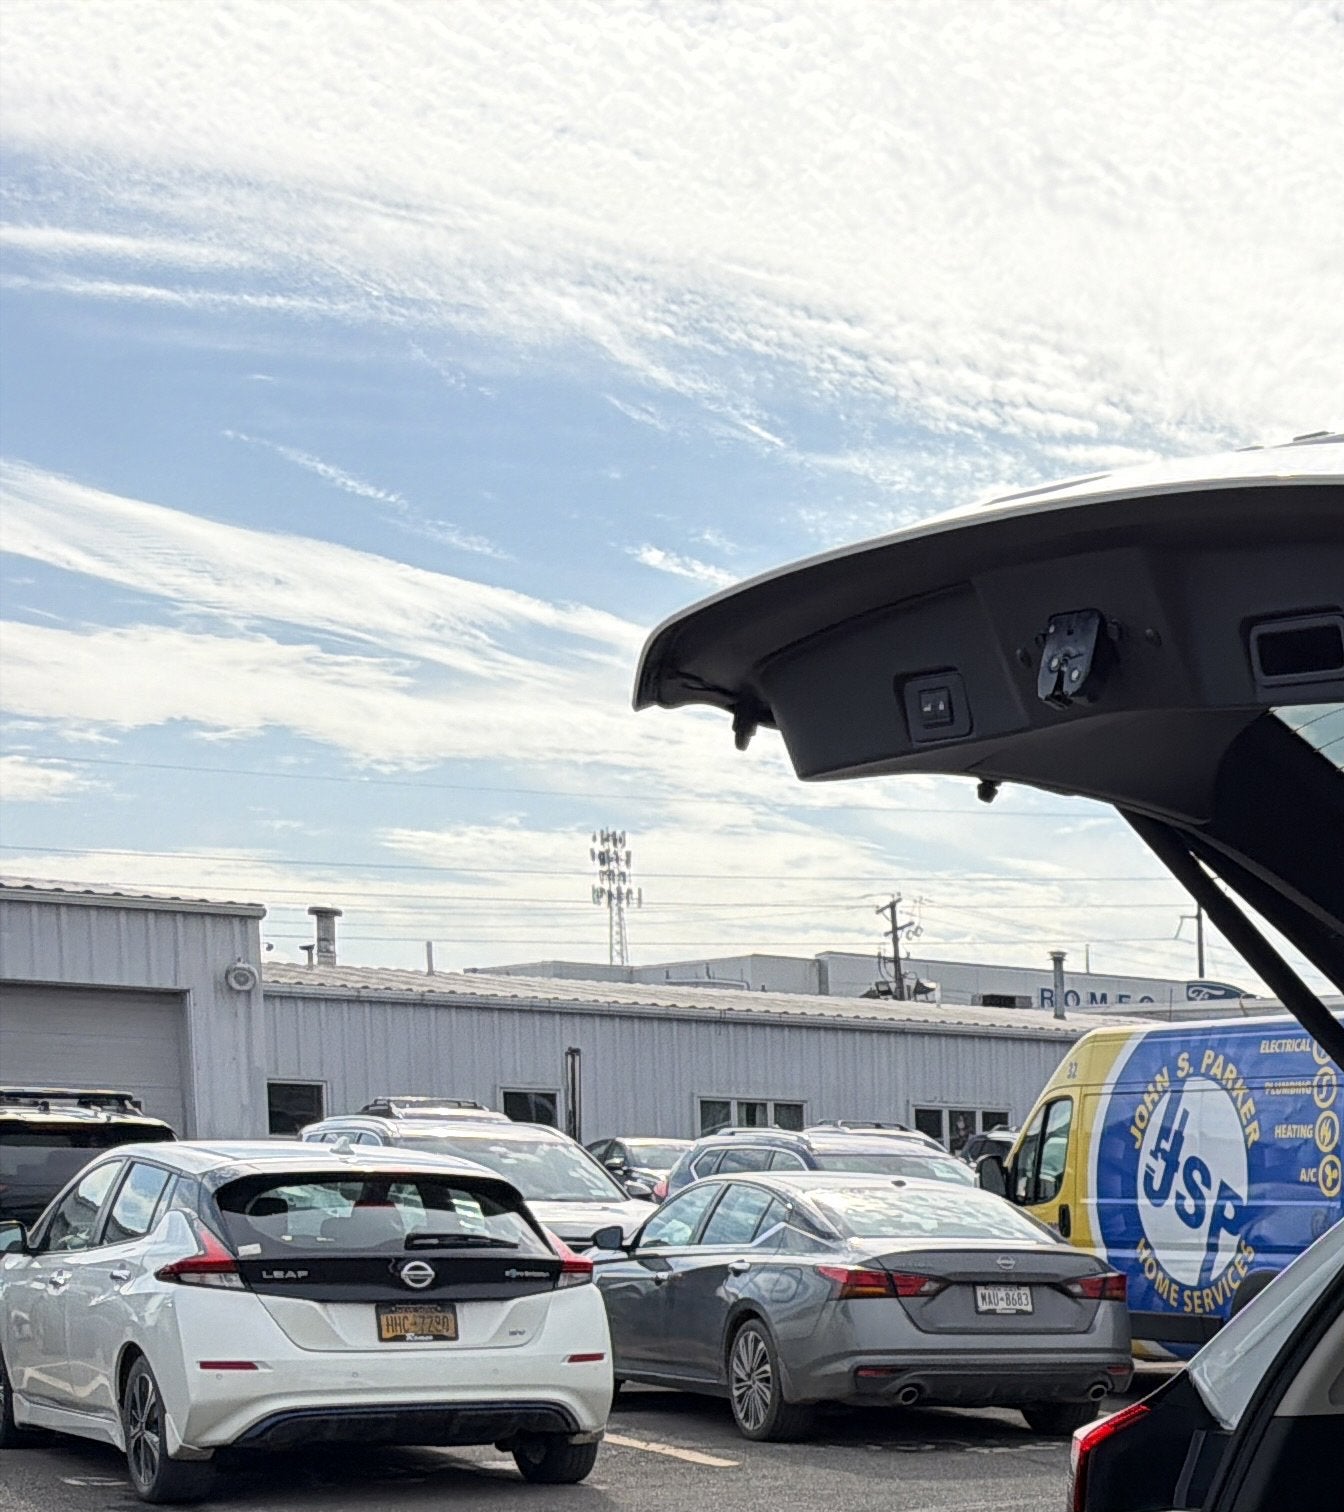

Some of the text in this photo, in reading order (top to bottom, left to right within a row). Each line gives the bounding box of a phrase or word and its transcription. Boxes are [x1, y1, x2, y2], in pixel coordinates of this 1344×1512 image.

[1260, 1039, 1311, 1054] ELECTRICAL
[1130, 1049, 1260, 1149] JOHN S. PARKER
[1274, 1124, 1313, 1139] HEATING
[1300, 1168, 1317, 1182] A/C
[262, 1270, 309, 1279] LEAF
[1136, 1238, 1255, 1314] HOME SERVICES
